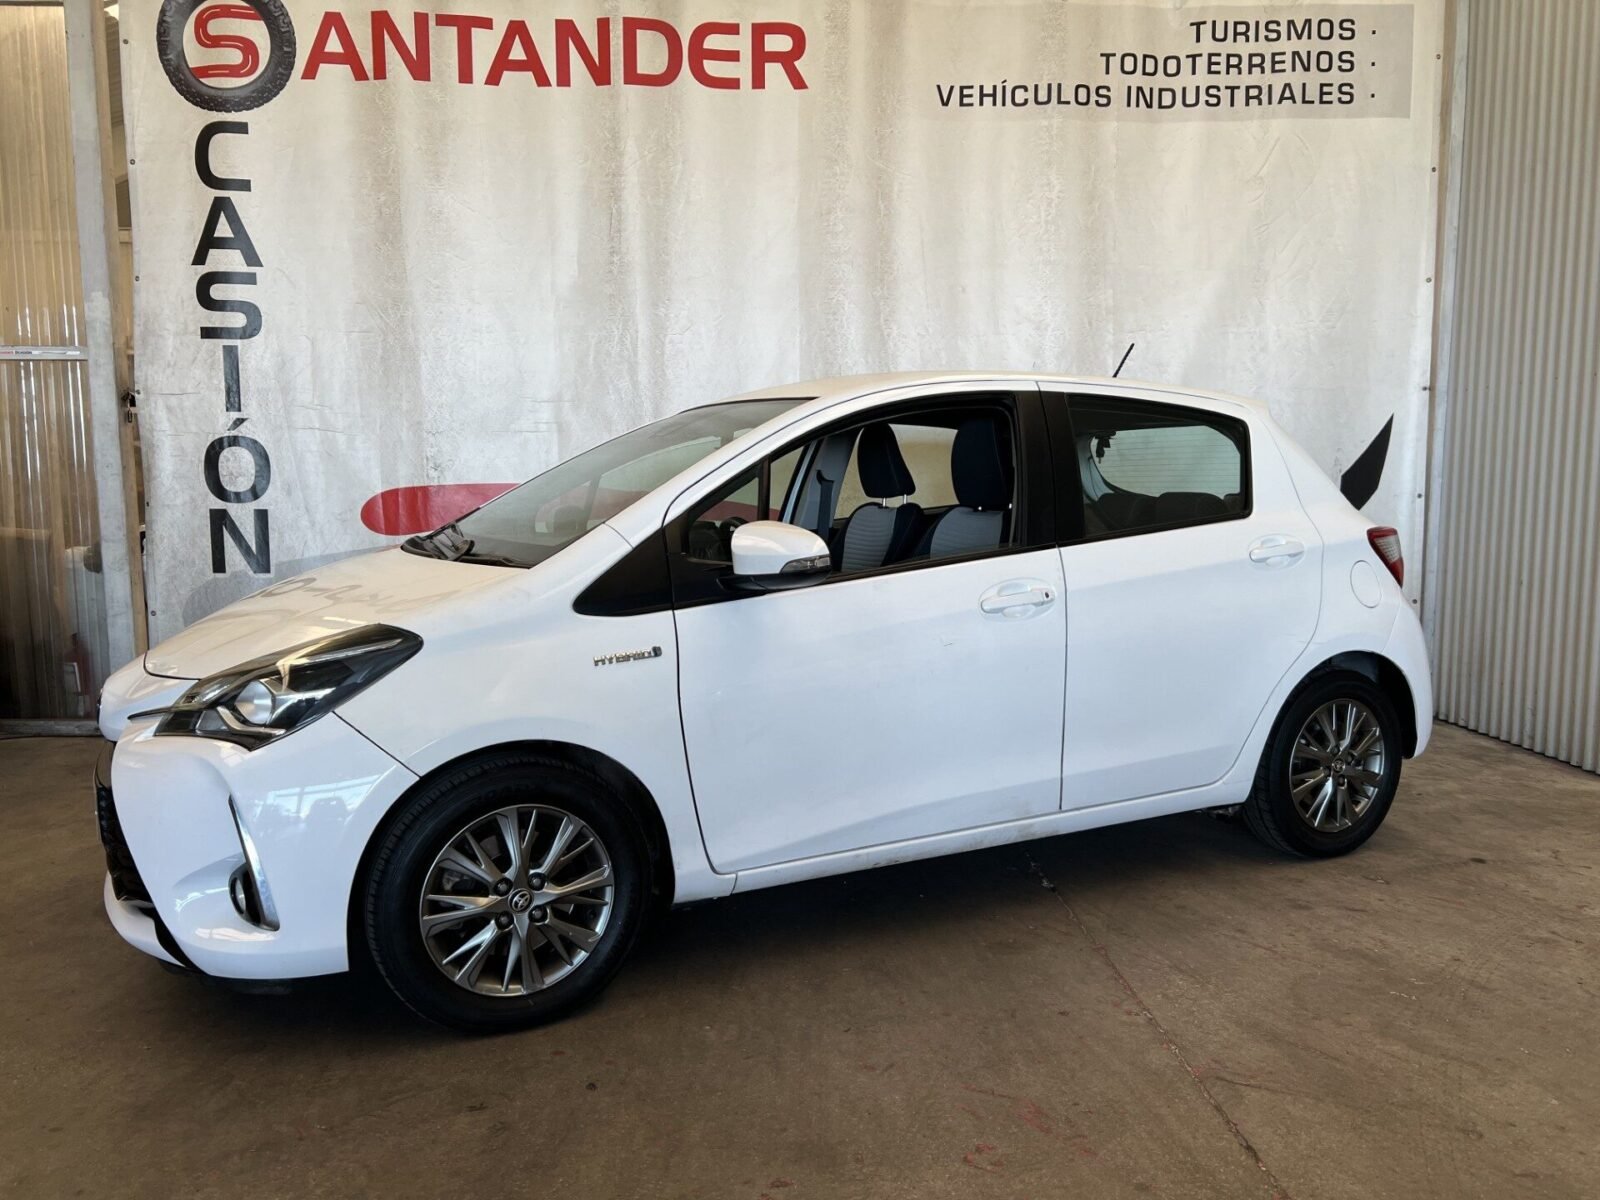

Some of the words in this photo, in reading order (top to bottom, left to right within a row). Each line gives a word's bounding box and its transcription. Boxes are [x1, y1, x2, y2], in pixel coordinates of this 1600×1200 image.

[1189, 17, 1357, 44] TURISMOS
[1100, 50, 1356, 77] TODOTERRENOS
[936, 79, 1112, 108] VEHÍCULOS
[1125, 82, 1355, 110] INDUSTRIALES
